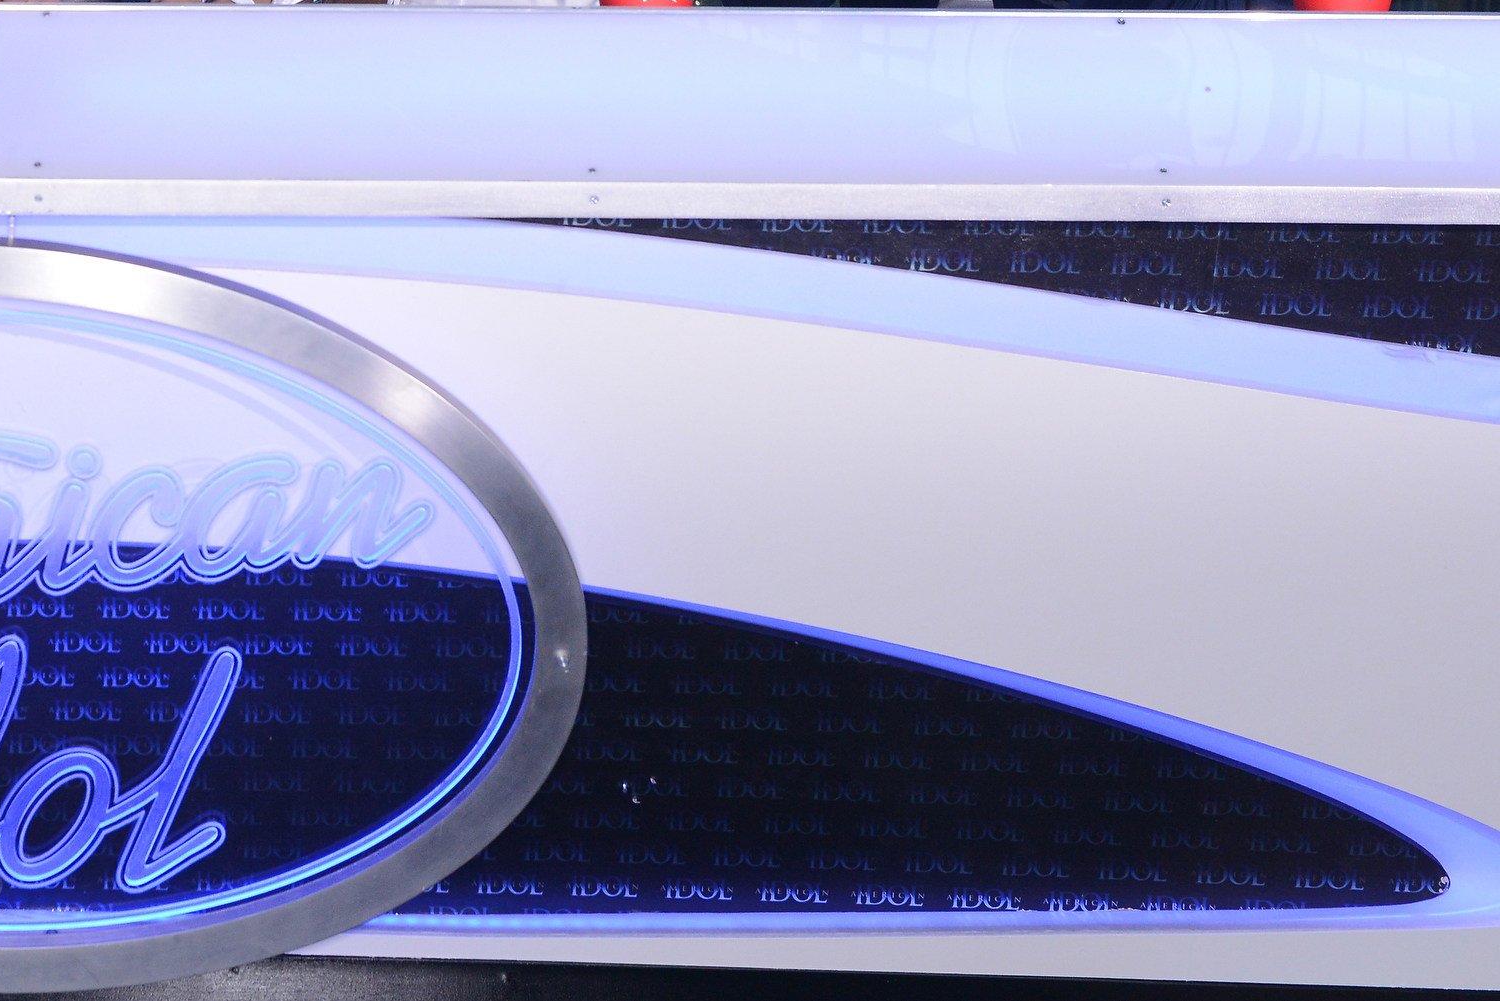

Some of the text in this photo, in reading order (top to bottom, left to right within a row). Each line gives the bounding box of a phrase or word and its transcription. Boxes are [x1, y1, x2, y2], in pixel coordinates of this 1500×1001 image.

[1167, 222, 1238, 241] IDOL
[1269, 223, 1341, 243] IDOL
[1372, 224, 1444, 245] IDOL
[910, 249, 981, 273] IDOL
[1010, 251, 1081, 275] IDOL
[1112, 253, 1182, 277] IDOL
[1213, 256, 1284, 279] IDOL
[1315, 257, 1387, 281] IDOL
[1419, 259, 1491, 284] IDOL
[1260, 293, 1332, 317] IDOL
[1363, 295, 1435, 319] IDOL
[6, 594, 74, 618] IDOL
[102, 595, 170, 619] IDOL
[197, 596, 265, 620] IDOL
[293, 598, 361, 622] IDOL
[389, 599, 457, 623] IDOL
[53, 629, 121, 653] IDOL
[148, 630, 216, 654] IDOL
[244, 631, 312, 655] IDOL
[339, 633, 407, 657] IDOL
[435, 634, 503, 658] IDOL
[627, 635, 695, 659] IDOL
[723, 638, 791, 662] IDOL
[22, 663, 75, 687] DOL
[102, 664, 170, 688] IDOL
[292, 667, 360, 691] IDOL
[387, 668, 455, 692] IDOL
[674, 671, 742, 695] IDOL
[771, 673, 839, 697] IDOL
[54, 697, 122, 721] IDOL
[243, 700, 311, 724] IDOL
[338, 701, 406, 725] IDOL
[624, 704, 692, 728] IDOL
[720, 706, 788, 730] IDOL
[817, 709, 885, 733] IDOL
[914, 712, 982, 736] IDOL
[576, 737, 644, 761] IDOL
[671, 740, 739, 764] IDOL
[767, 742, 835, 766] IDOL
[864, 745, 932, 769] IDOL
[961, 748, 1029, 772] IDOL
[717, 775, 785, 799] IDOL
[813, 778, 881, 802] IDOL
[1007, 785, 1075, 809] IDOL
[573, 805, 641, 829] IDOL
[1203, 793, 1271, 817] IDOL
[668, 808, 736, 832] IDOL
[764, 811, 832, 835] IDOL
[860, 814, 928, 838] IDOL
[1054, 821, 1122, 845] IDOL
[1151, 825, 1219, 849] IDOL
[1250, 829, 1318, 853] IDOL
[618, 841, 686, 865] IDOL
[713, 843, 781, 867] IDOL
[809, 847, 877, 871] IDOL
[905, 850, 973, 874] IDOL
[1002, 854, 1070, 878] IDOL
[1099, 858, 1167, 882] IDOL
[1197, 862, 1265, 886] IDOL
[476, 871, 544, 895] IDOL
[570, 874, 638, 898] IDOL
[665, 876, 733, 900] IDOL
[760, 879, 828, 903] IDOL
[1296, 867, 1364, 891] IDOL
[856, 882, 924, 906] IDOL
[952, 884, 1020, 908] IDOL
